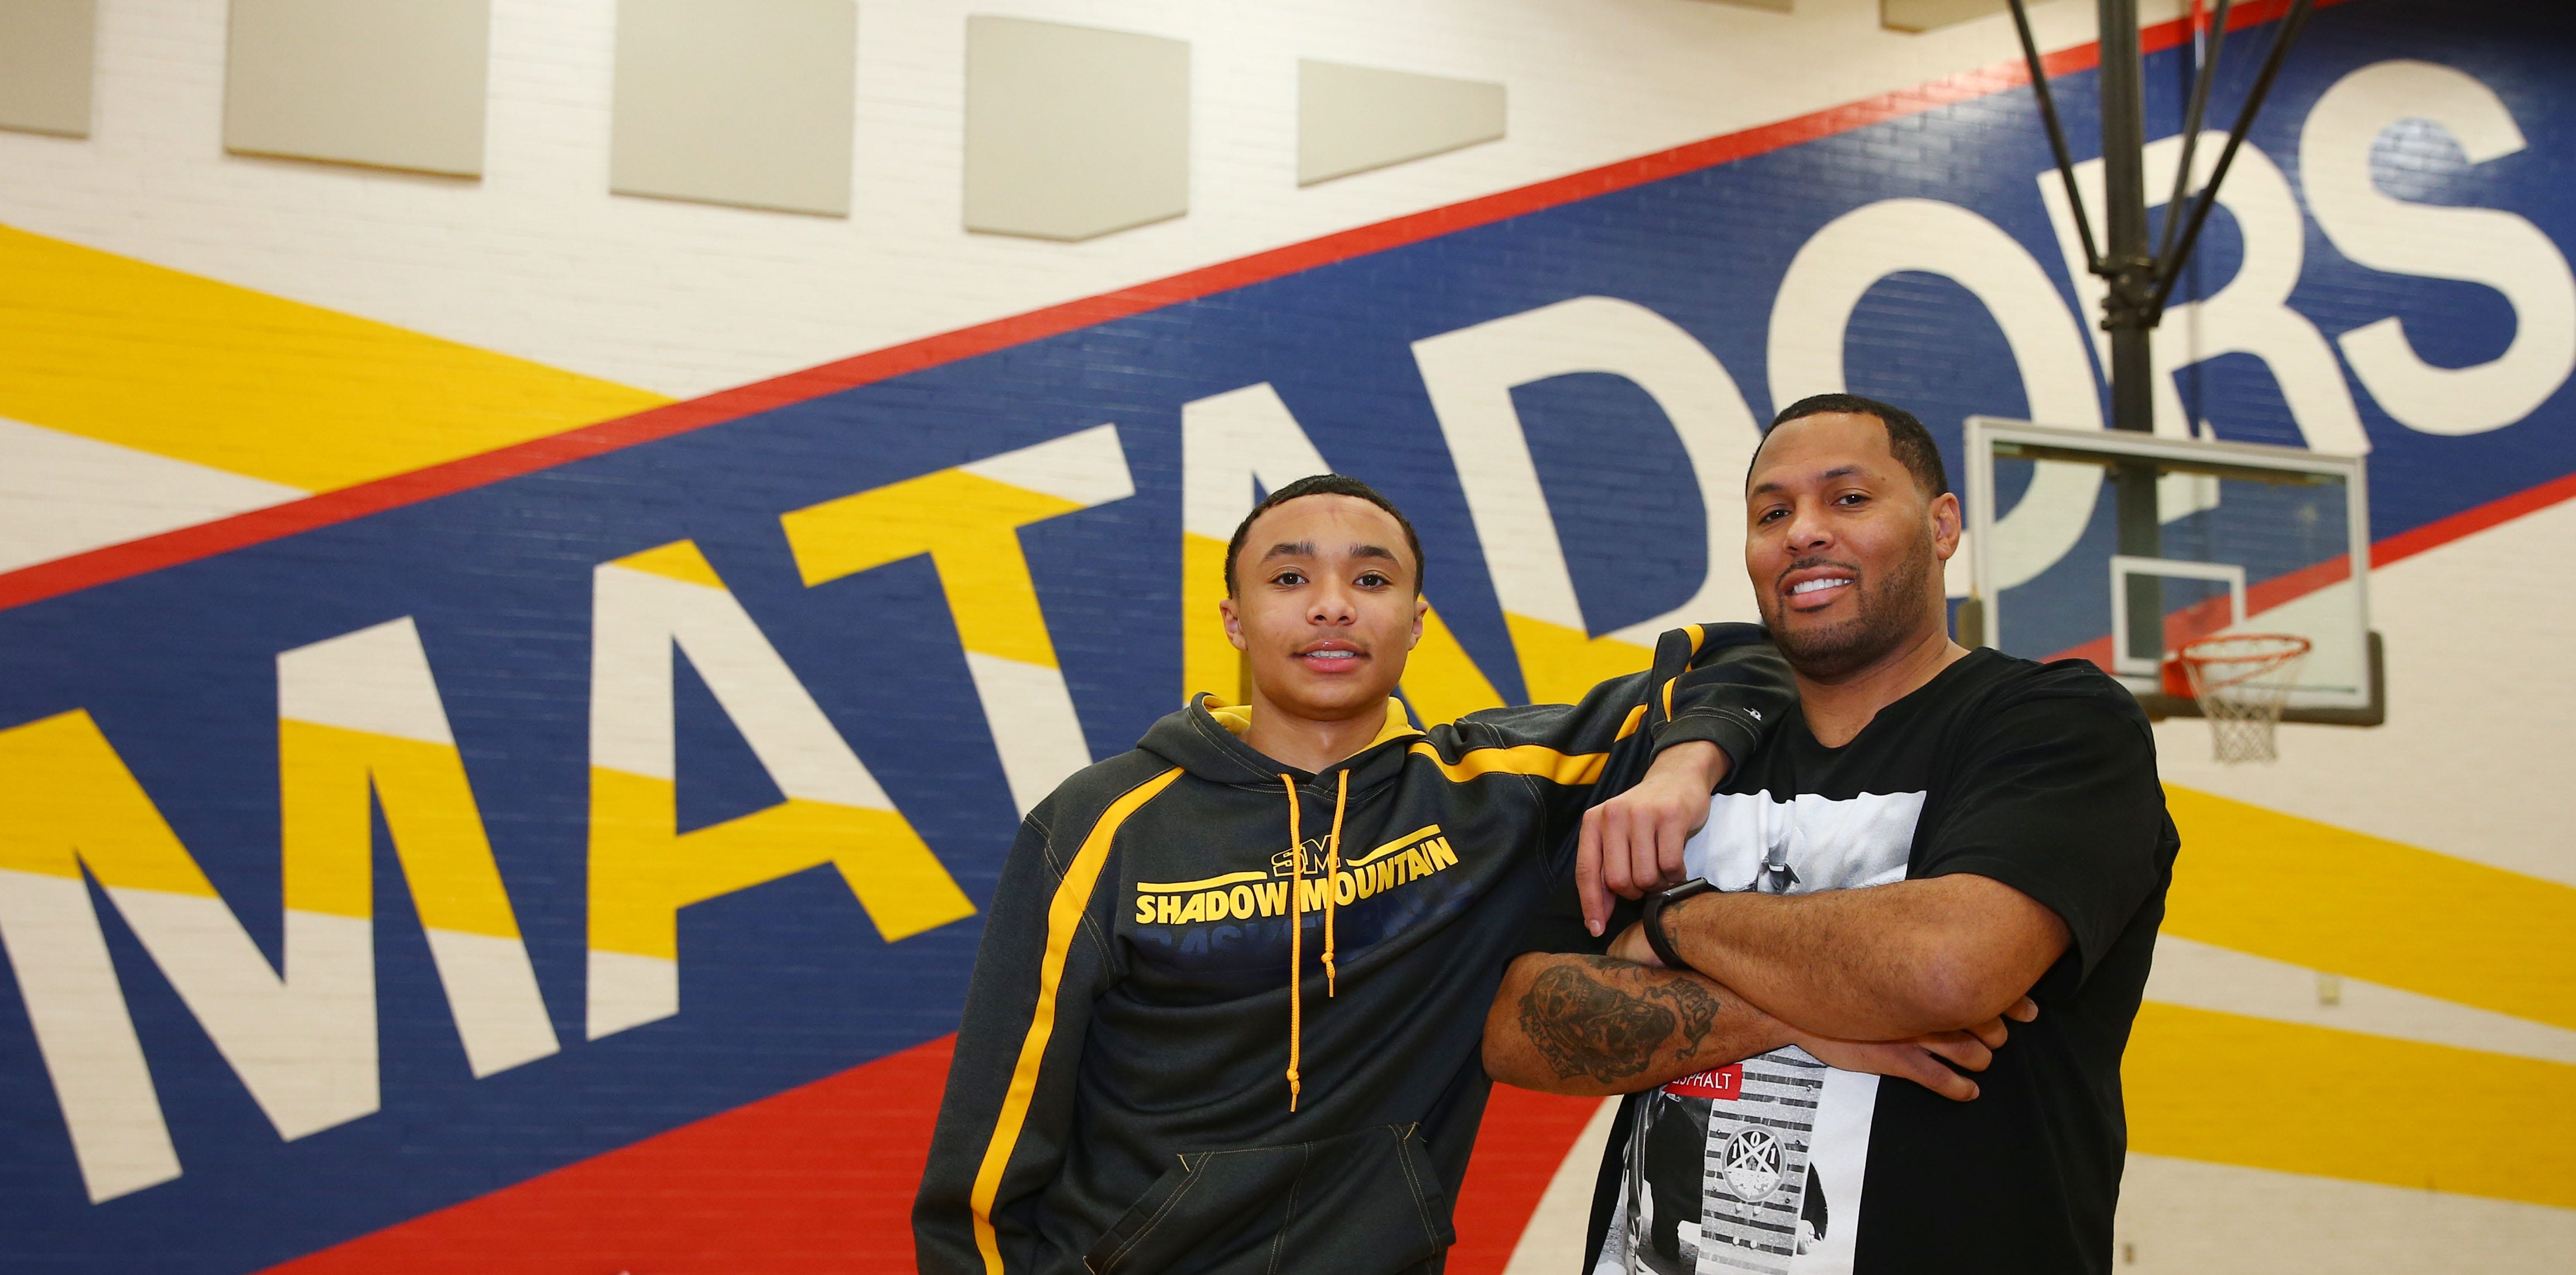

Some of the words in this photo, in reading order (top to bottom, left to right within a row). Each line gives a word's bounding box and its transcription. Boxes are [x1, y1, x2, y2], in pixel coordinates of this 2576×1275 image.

[0, 59, 2576, 1205] MATADORS
[1135, 880, 1289, 925] SHADOW
[1298, 836, 1459, 914] MOUNTAIN
